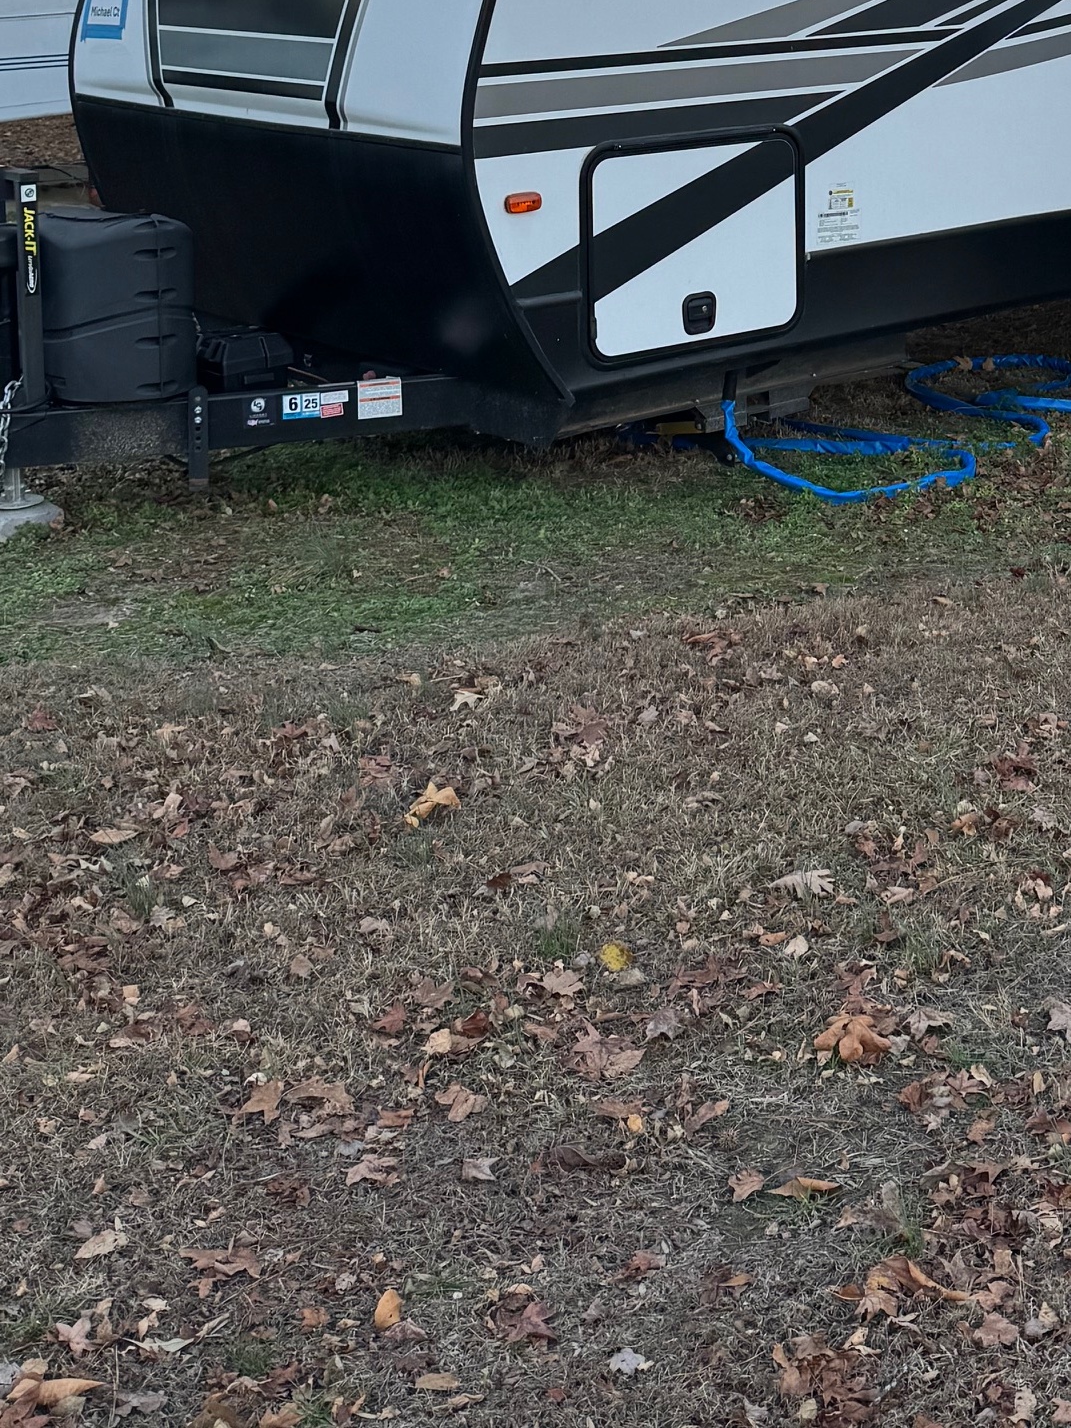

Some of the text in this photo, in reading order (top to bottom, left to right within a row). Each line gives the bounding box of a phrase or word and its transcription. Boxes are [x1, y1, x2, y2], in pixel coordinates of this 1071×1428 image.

[91, 6, 112, 18] Michael
[23, 206, 37, 256] JACK-IT
[288, 397, 298, 411] 6
[304, 398, 318, 409] 25
